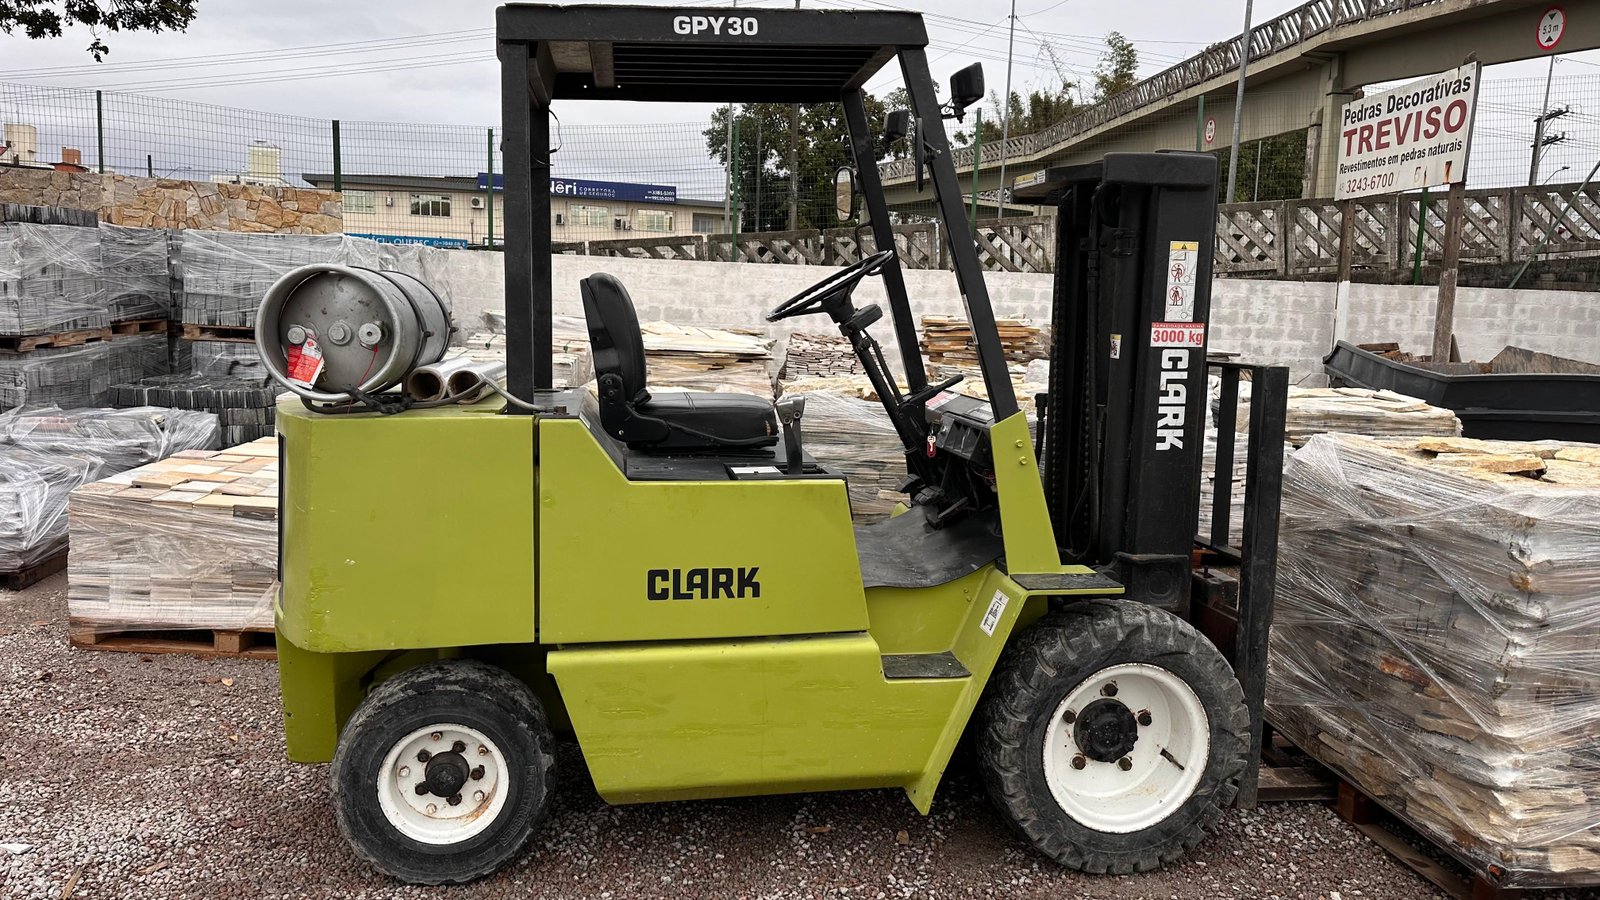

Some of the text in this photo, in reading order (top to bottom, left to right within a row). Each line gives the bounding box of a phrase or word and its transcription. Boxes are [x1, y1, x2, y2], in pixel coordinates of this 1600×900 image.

[673, 16, 758, 36] GPY30
[1344, 76, 1471, 126] Pedras Decorativas
[1343, 99, 1468, 157] TREVISO
[1340, 138, 1462, 174] Revestimentos em pedras naturais
[1346, 172, 1394, 193] 3243-6700
[1153, 330, 1203, 345] 3000 kg
[1156, 349, 1189, 451] CLARK
[647, 567, 760, 601] CLARK
